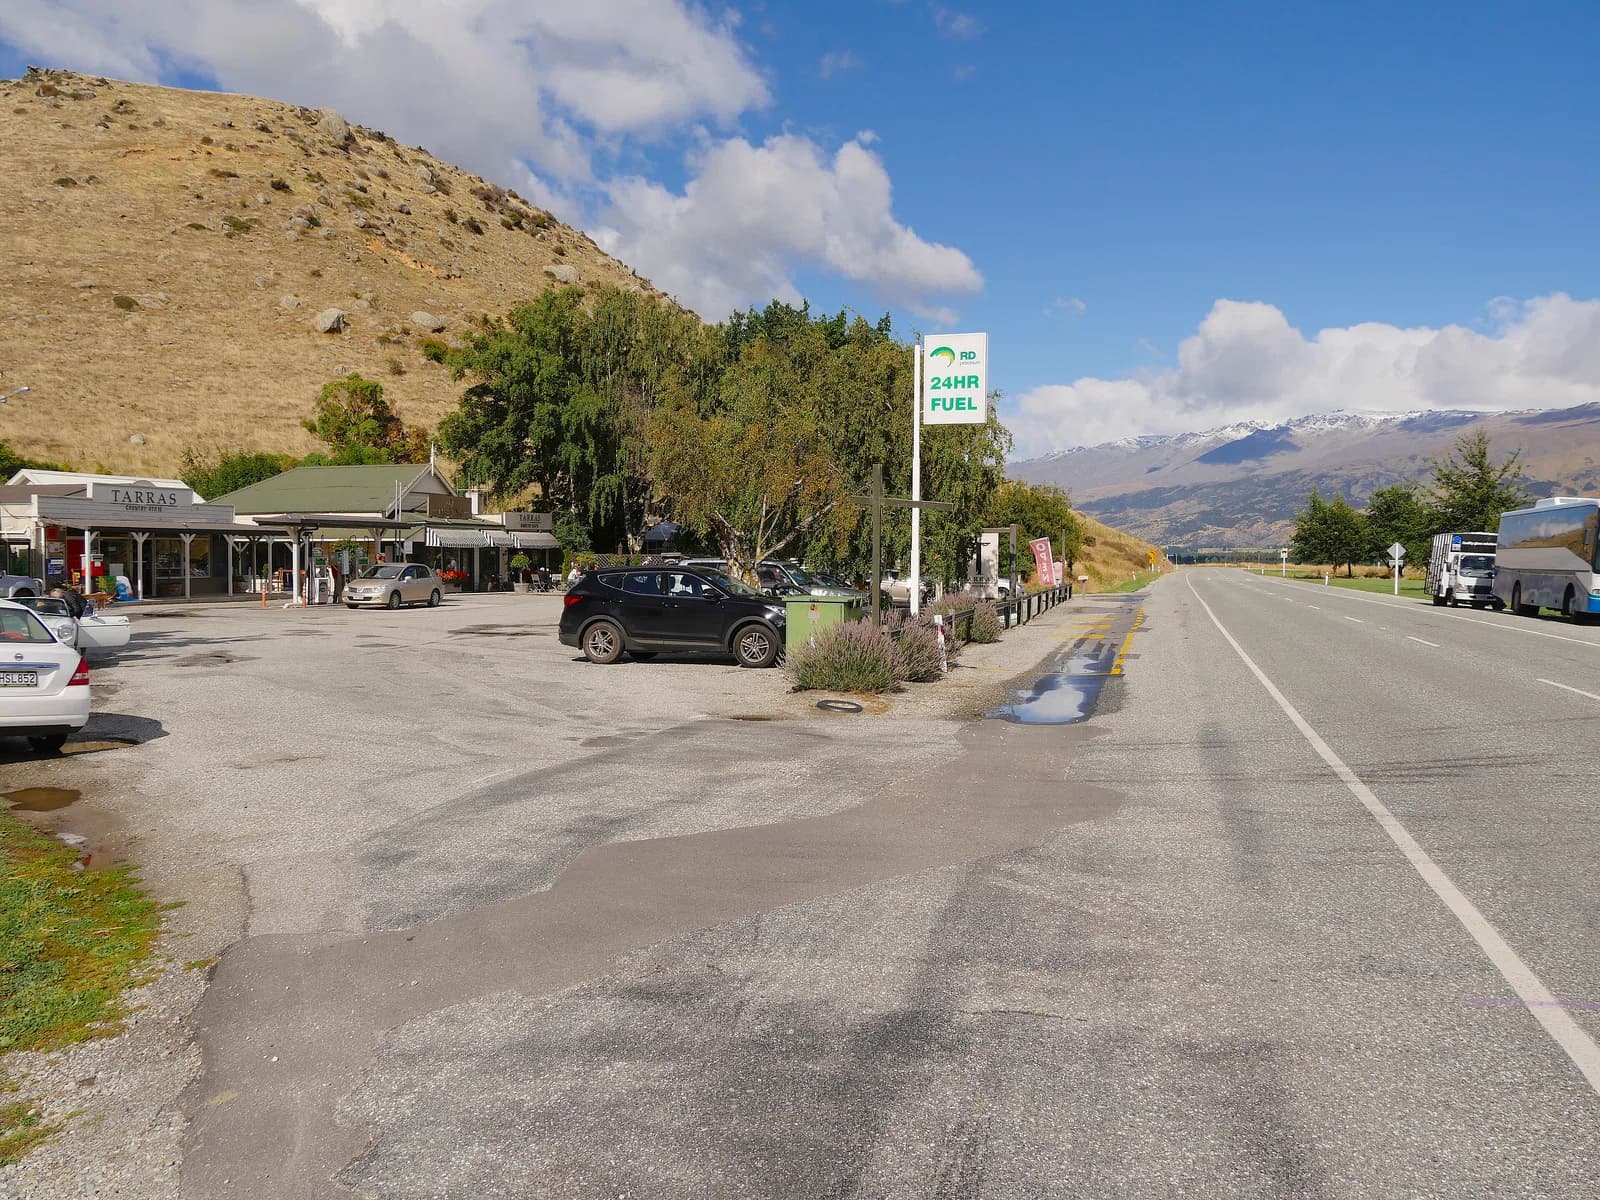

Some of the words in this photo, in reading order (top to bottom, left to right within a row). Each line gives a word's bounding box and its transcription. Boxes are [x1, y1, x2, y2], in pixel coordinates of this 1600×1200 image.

[960, 351, 976, 361] RD
[930, 375, 979, 390] 24HR
[930, 397, 977, 411] FUEL
[112, 489, 177, 505] TARRAS
